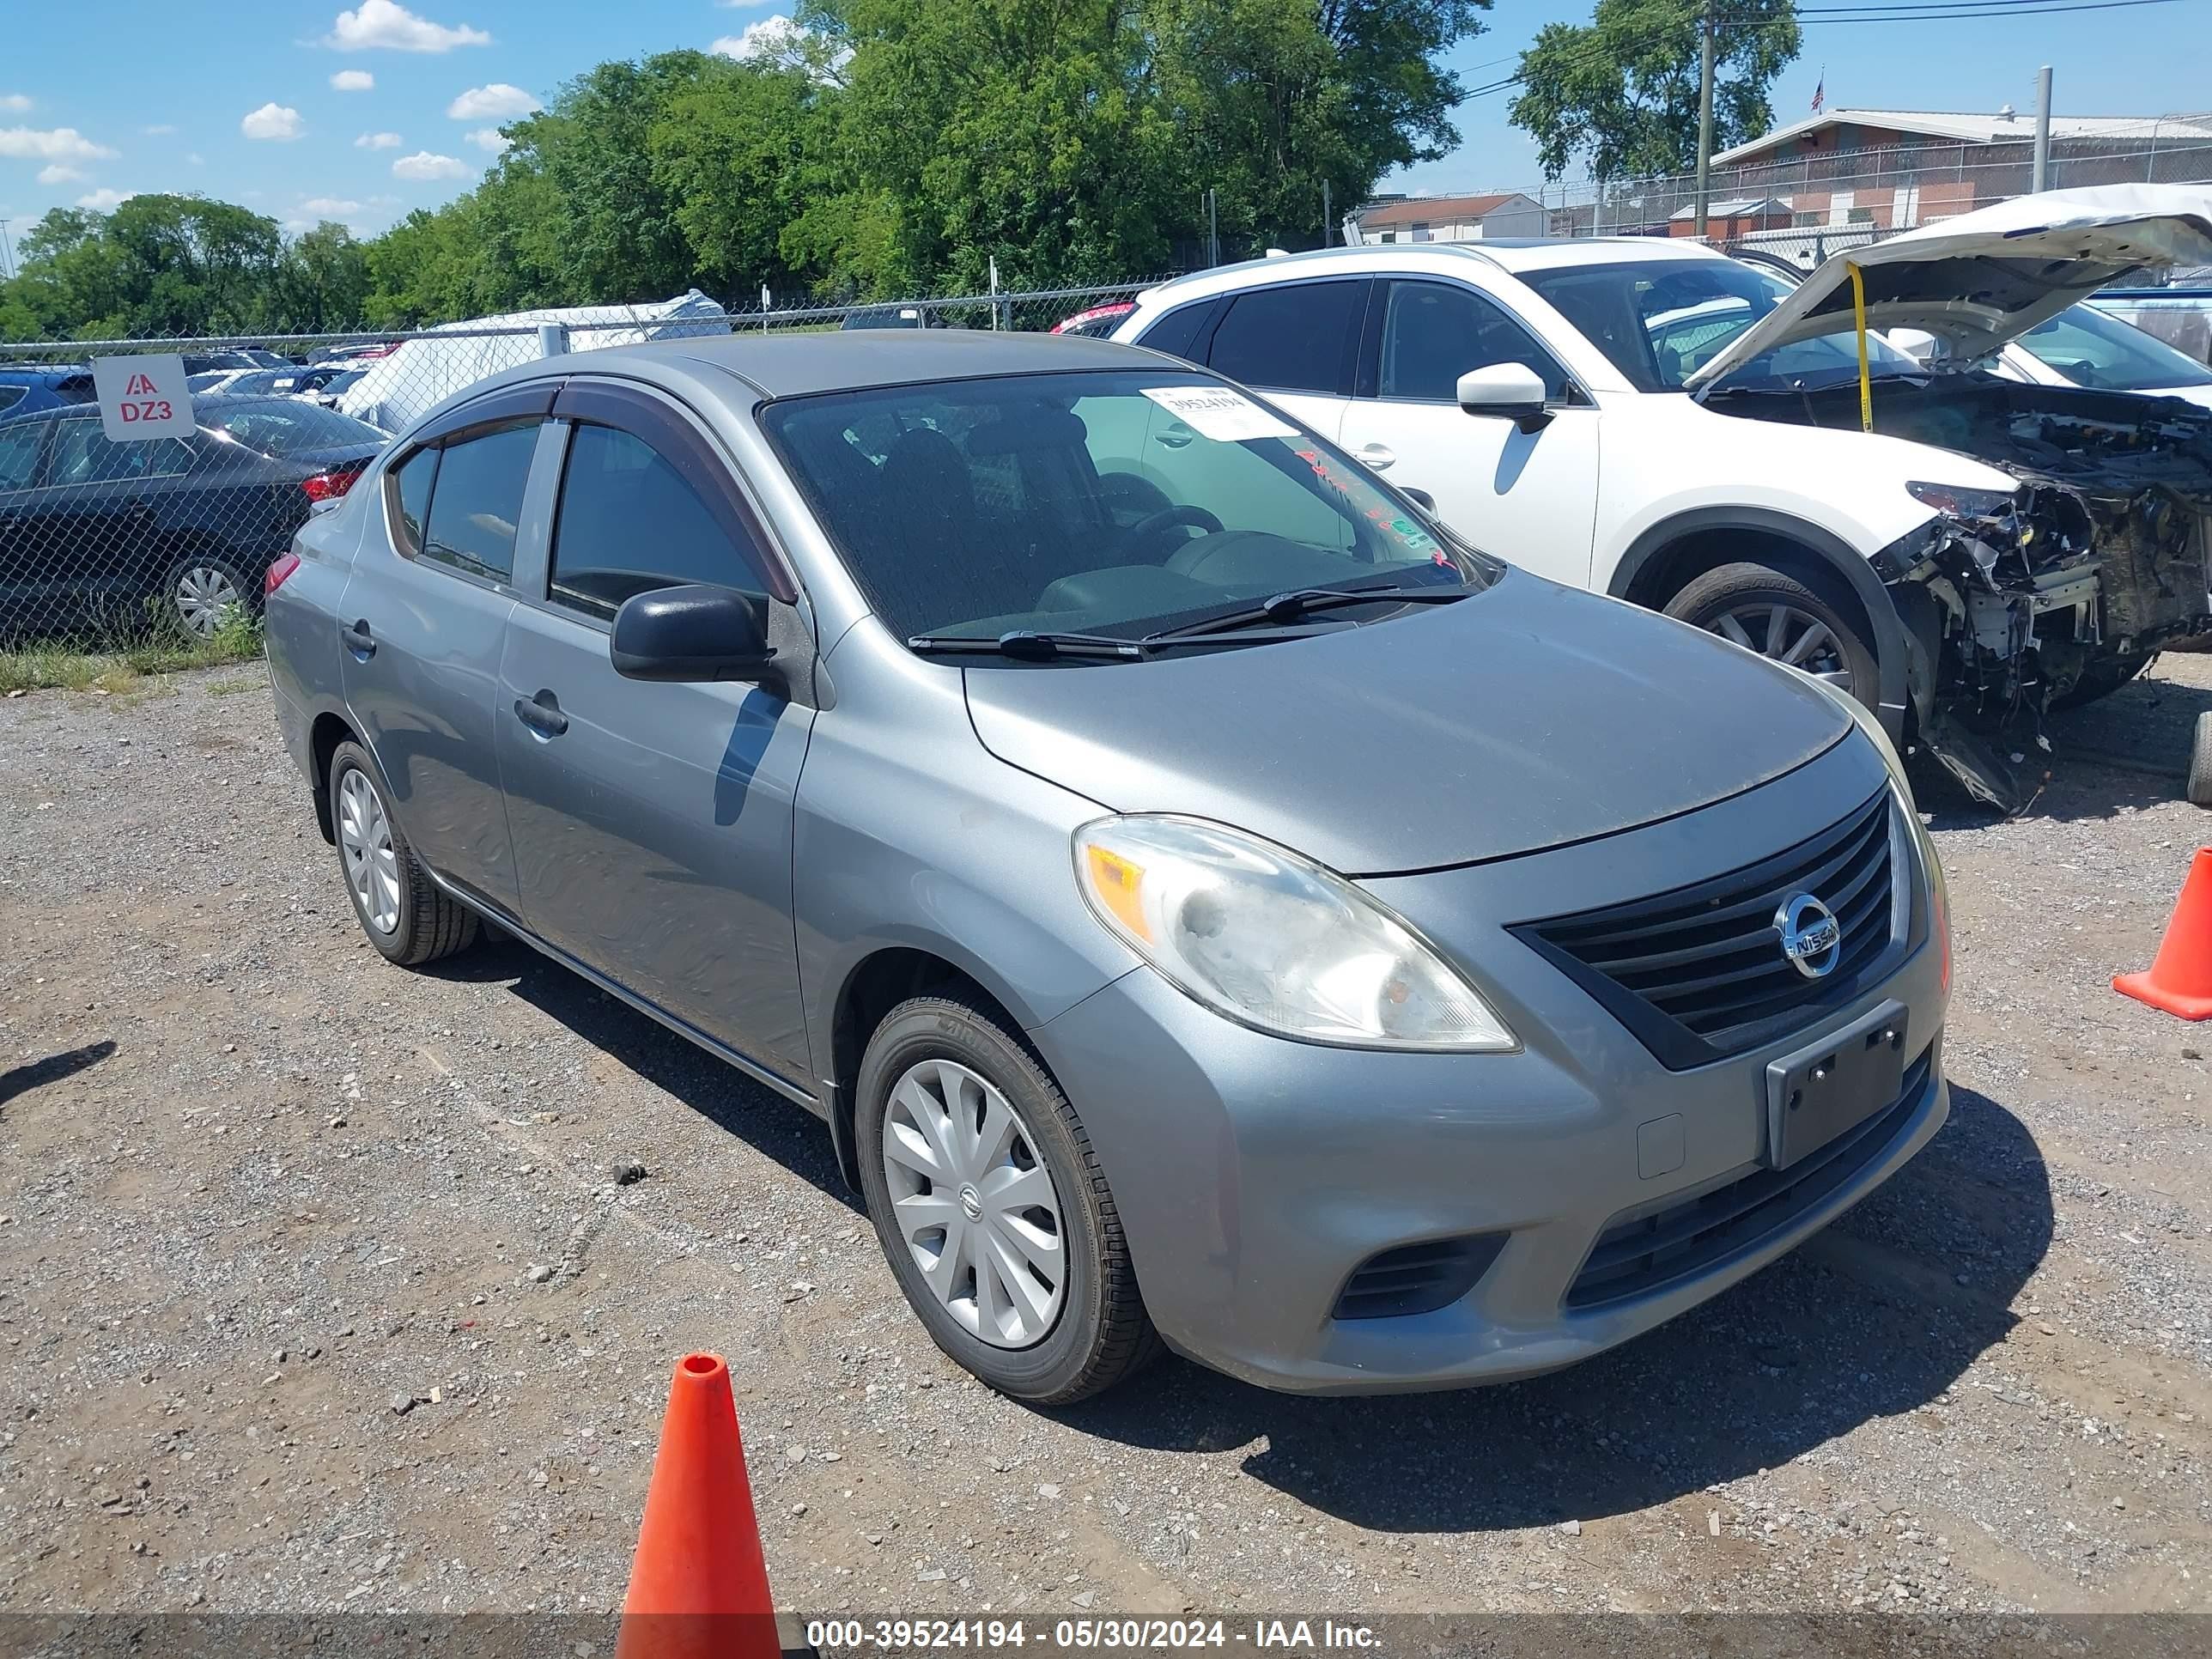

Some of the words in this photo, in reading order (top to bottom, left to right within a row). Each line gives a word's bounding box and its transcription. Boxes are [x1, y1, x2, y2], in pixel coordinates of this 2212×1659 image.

[120, 401, 173, 422] DZ3
[1168, 397, 1246, 411] 39524194
[1795, 923, 1839, 955] NISSAN
